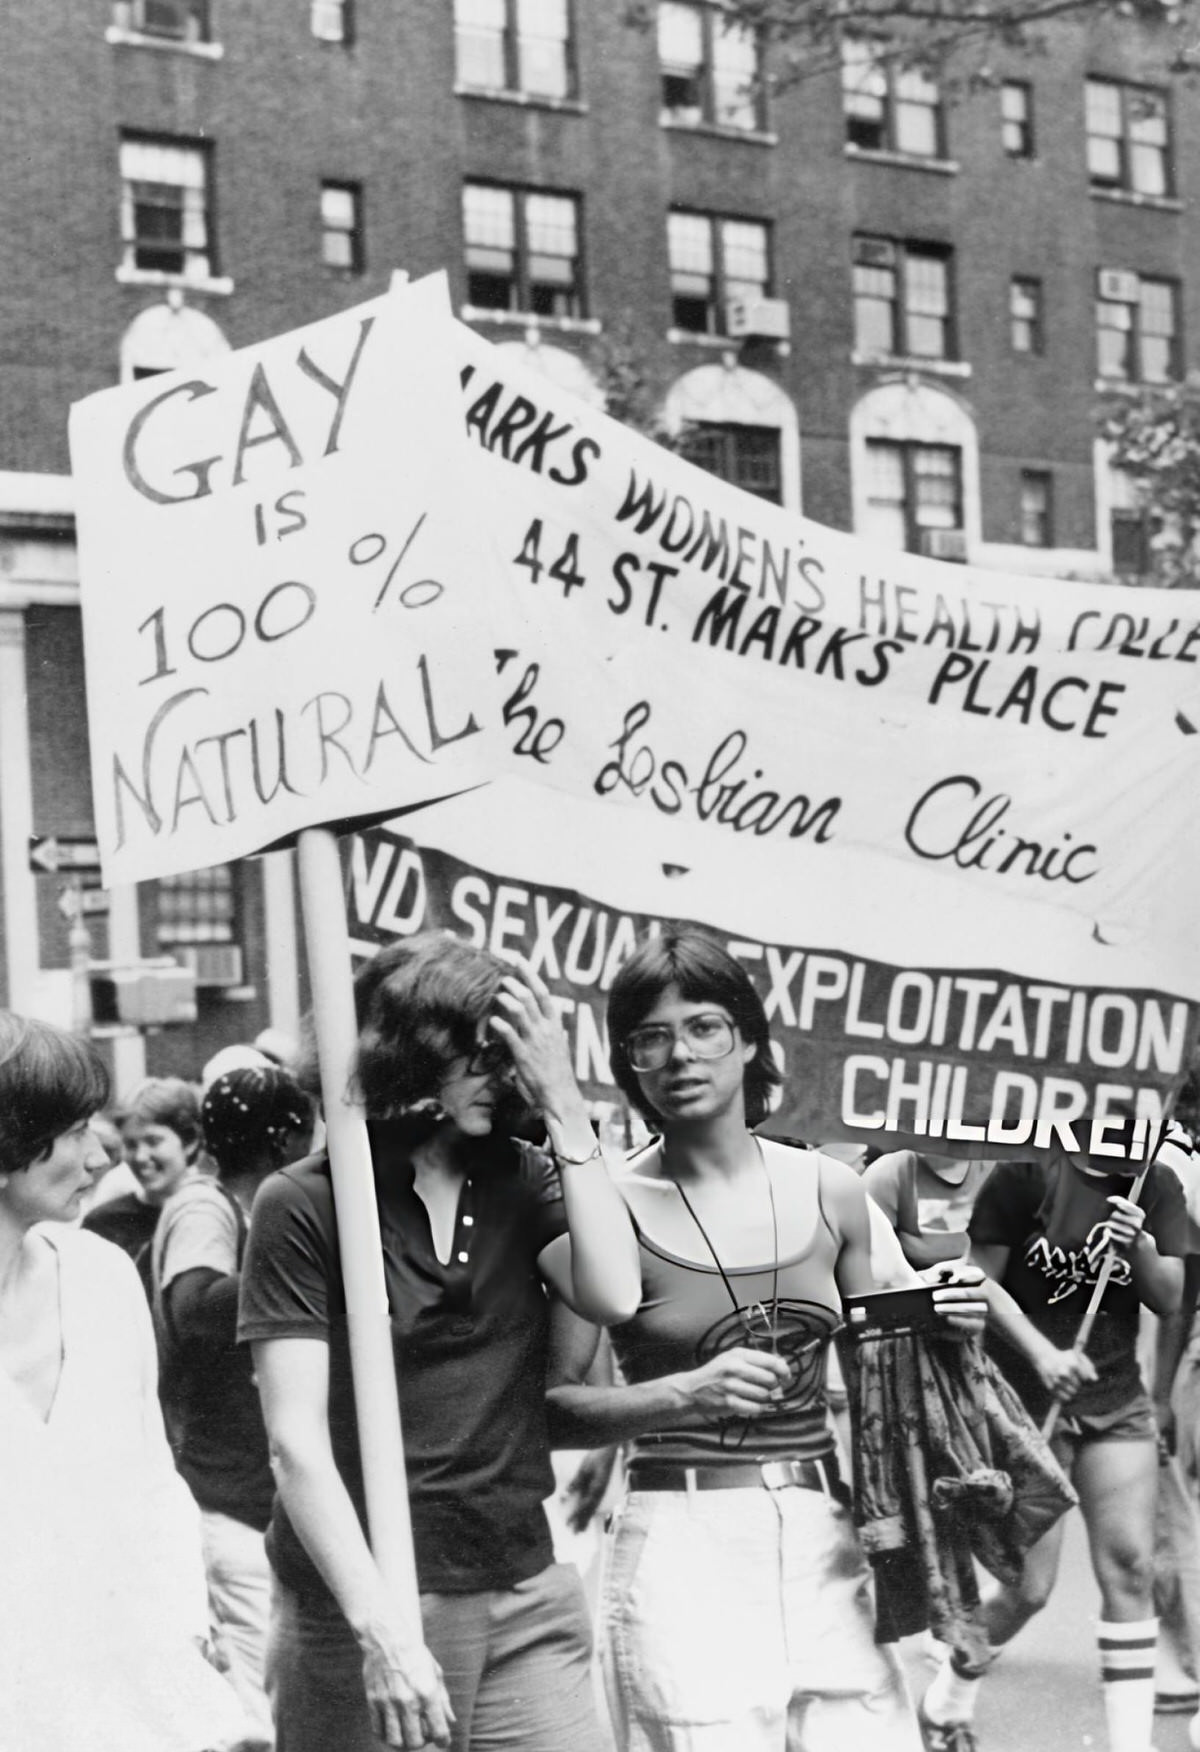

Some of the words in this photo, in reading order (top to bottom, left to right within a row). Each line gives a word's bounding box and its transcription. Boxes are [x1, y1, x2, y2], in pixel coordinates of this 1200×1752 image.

[123, 316, 376, 504] GAY
[254, 489, 308, 545] IS
[460, 364, 601, 485] ARKS
[858, 575, 1042, 655] HEALTH
[513, 518, 587, 599] 44
[606, 552, 681, 628] ST.
[691, 585, 905, 687] MARKS
[927, 652, 1127, 739] PLACE
[113, 653, 486, 852] NATURAL
[594, 700, 842, 844] Lesbian
[904, 774, 1101, 883] Clinic
[450, 875, 662, 992] SEXUA
